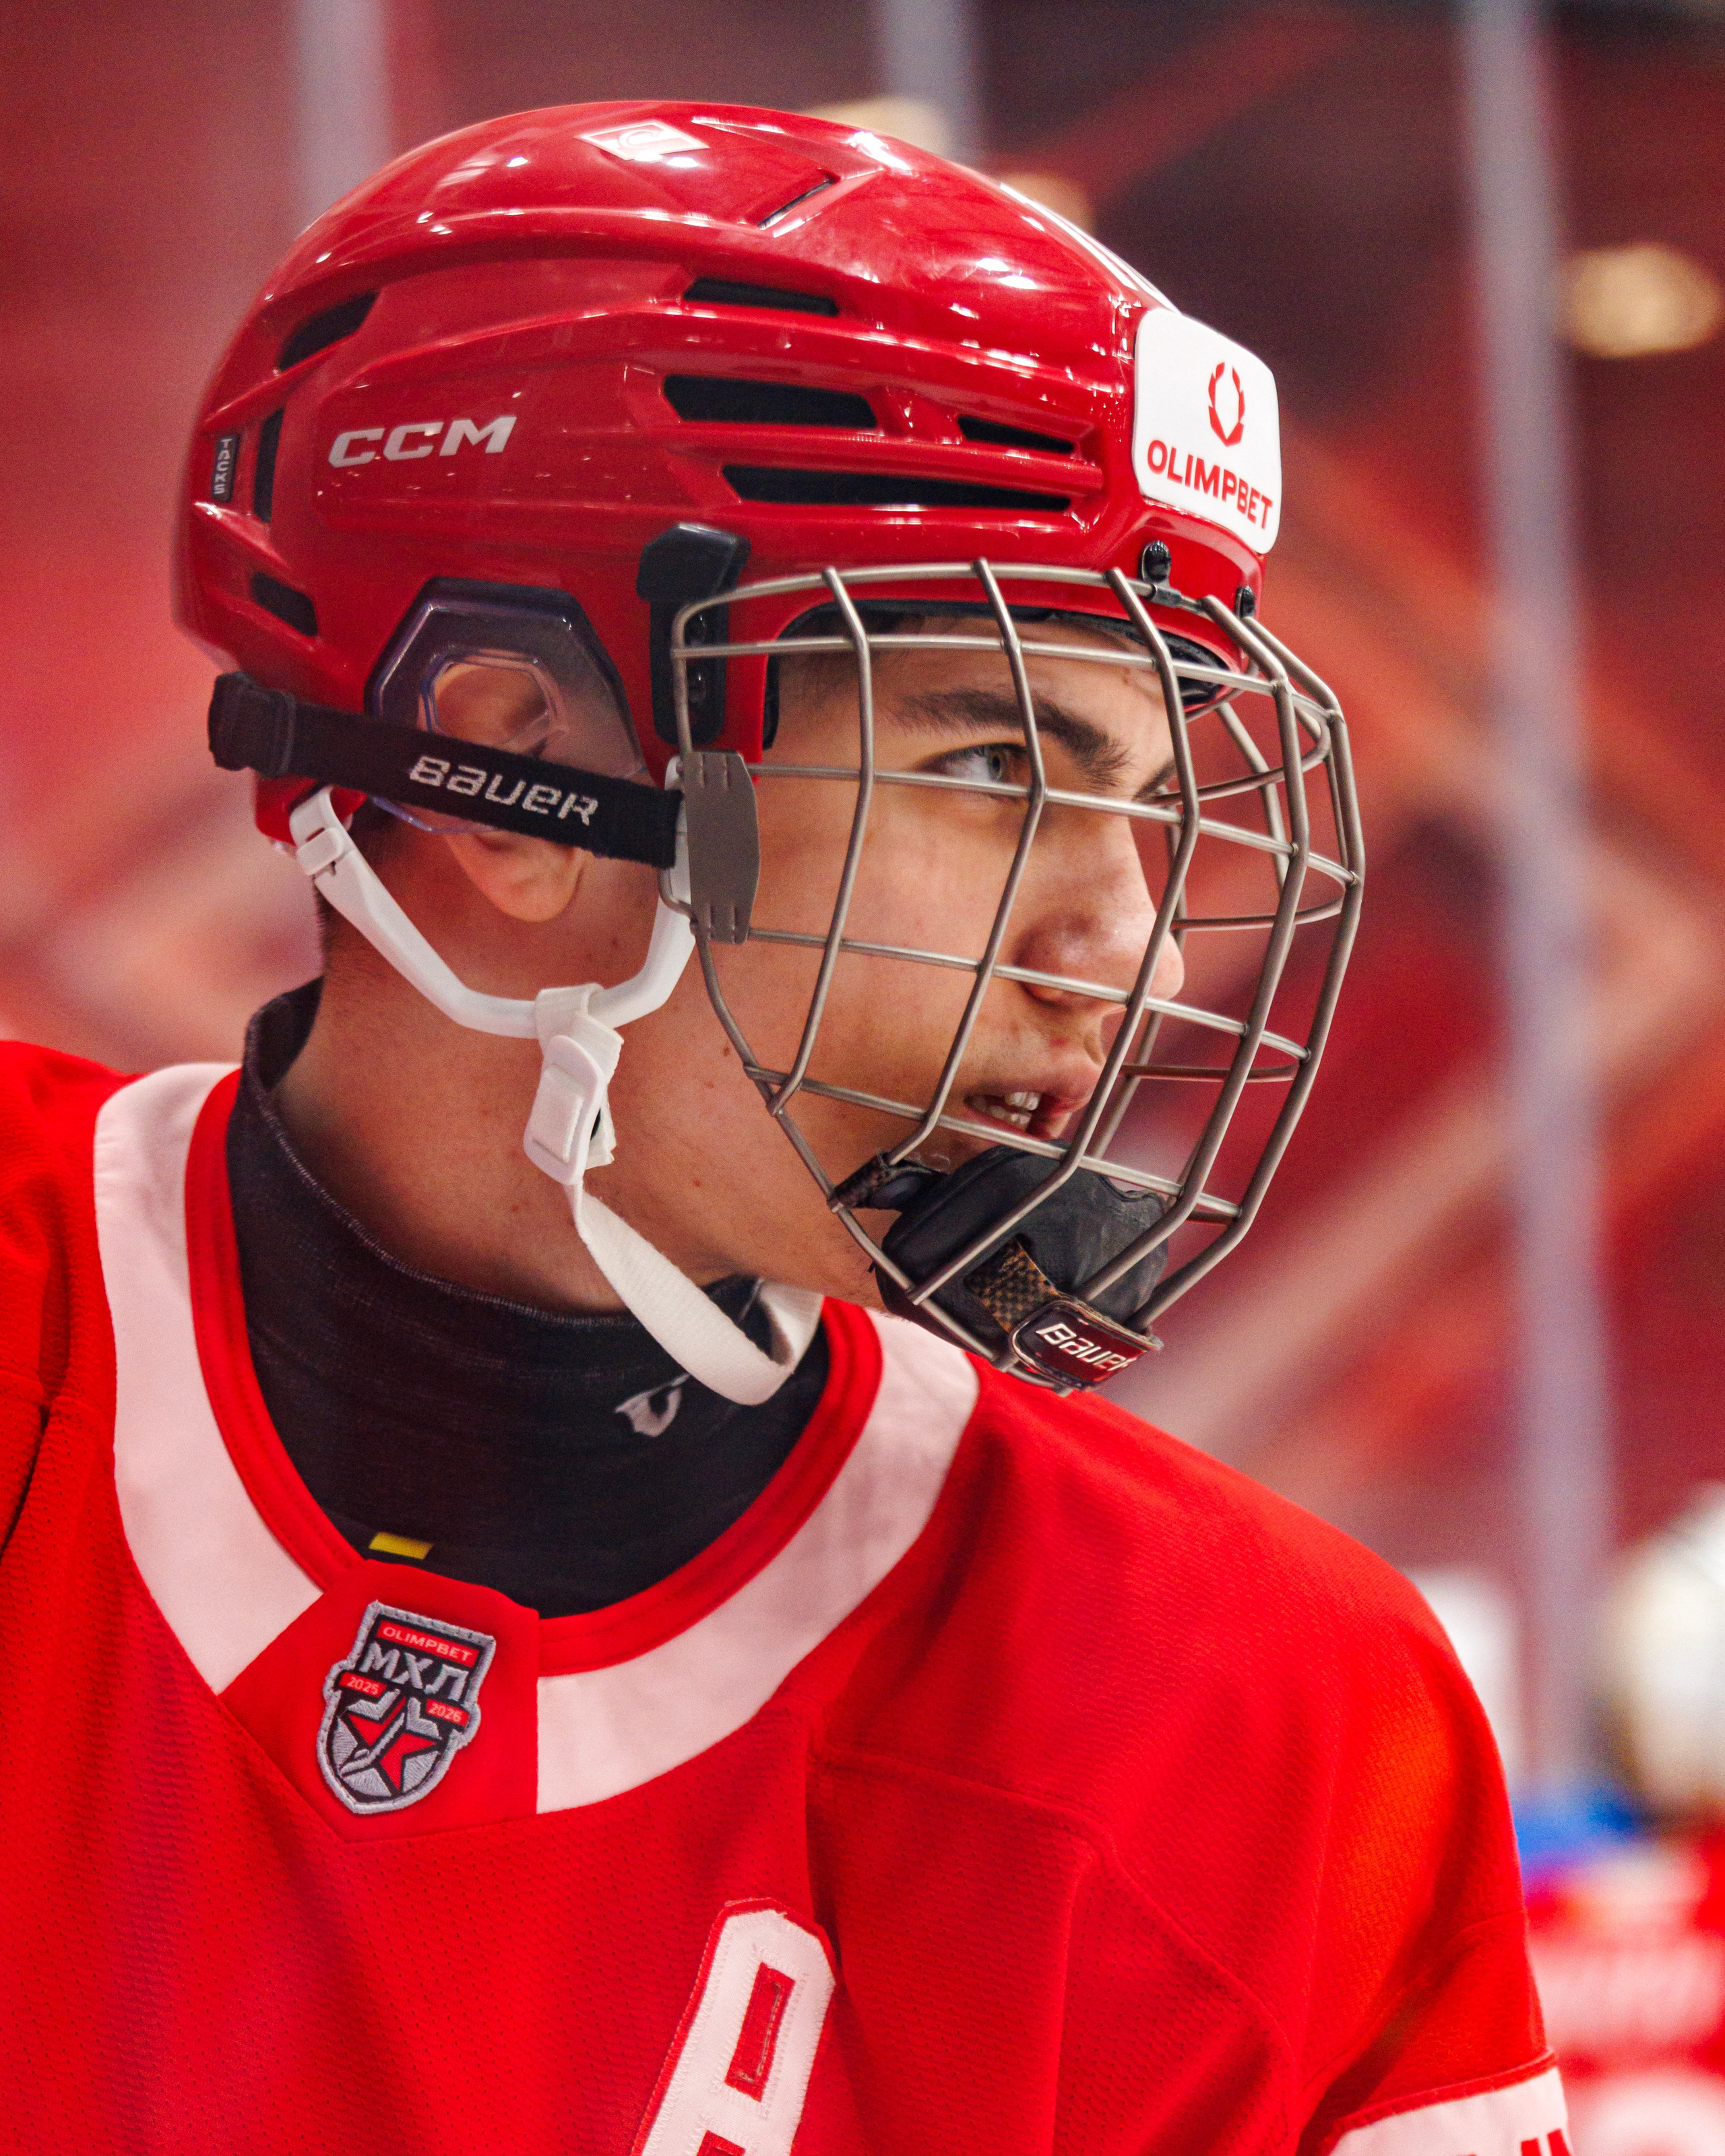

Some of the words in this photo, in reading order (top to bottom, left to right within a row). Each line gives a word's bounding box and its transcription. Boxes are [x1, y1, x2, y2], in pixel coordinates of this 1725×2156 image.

[214, 439, 232, 495] TACKS
[328, 416, 517, 468] CCM
[1147, 439, 1273, 530] OLIMPBET
[383, 1626, 472, 1661] OLIMPBET
[347, 1676, 379, 1695] 2025
[358, 1641, 470, 1702] МХЛ
[429, 1702, 463, 1723] 2026
[637, 1907, 836, 2156] A
